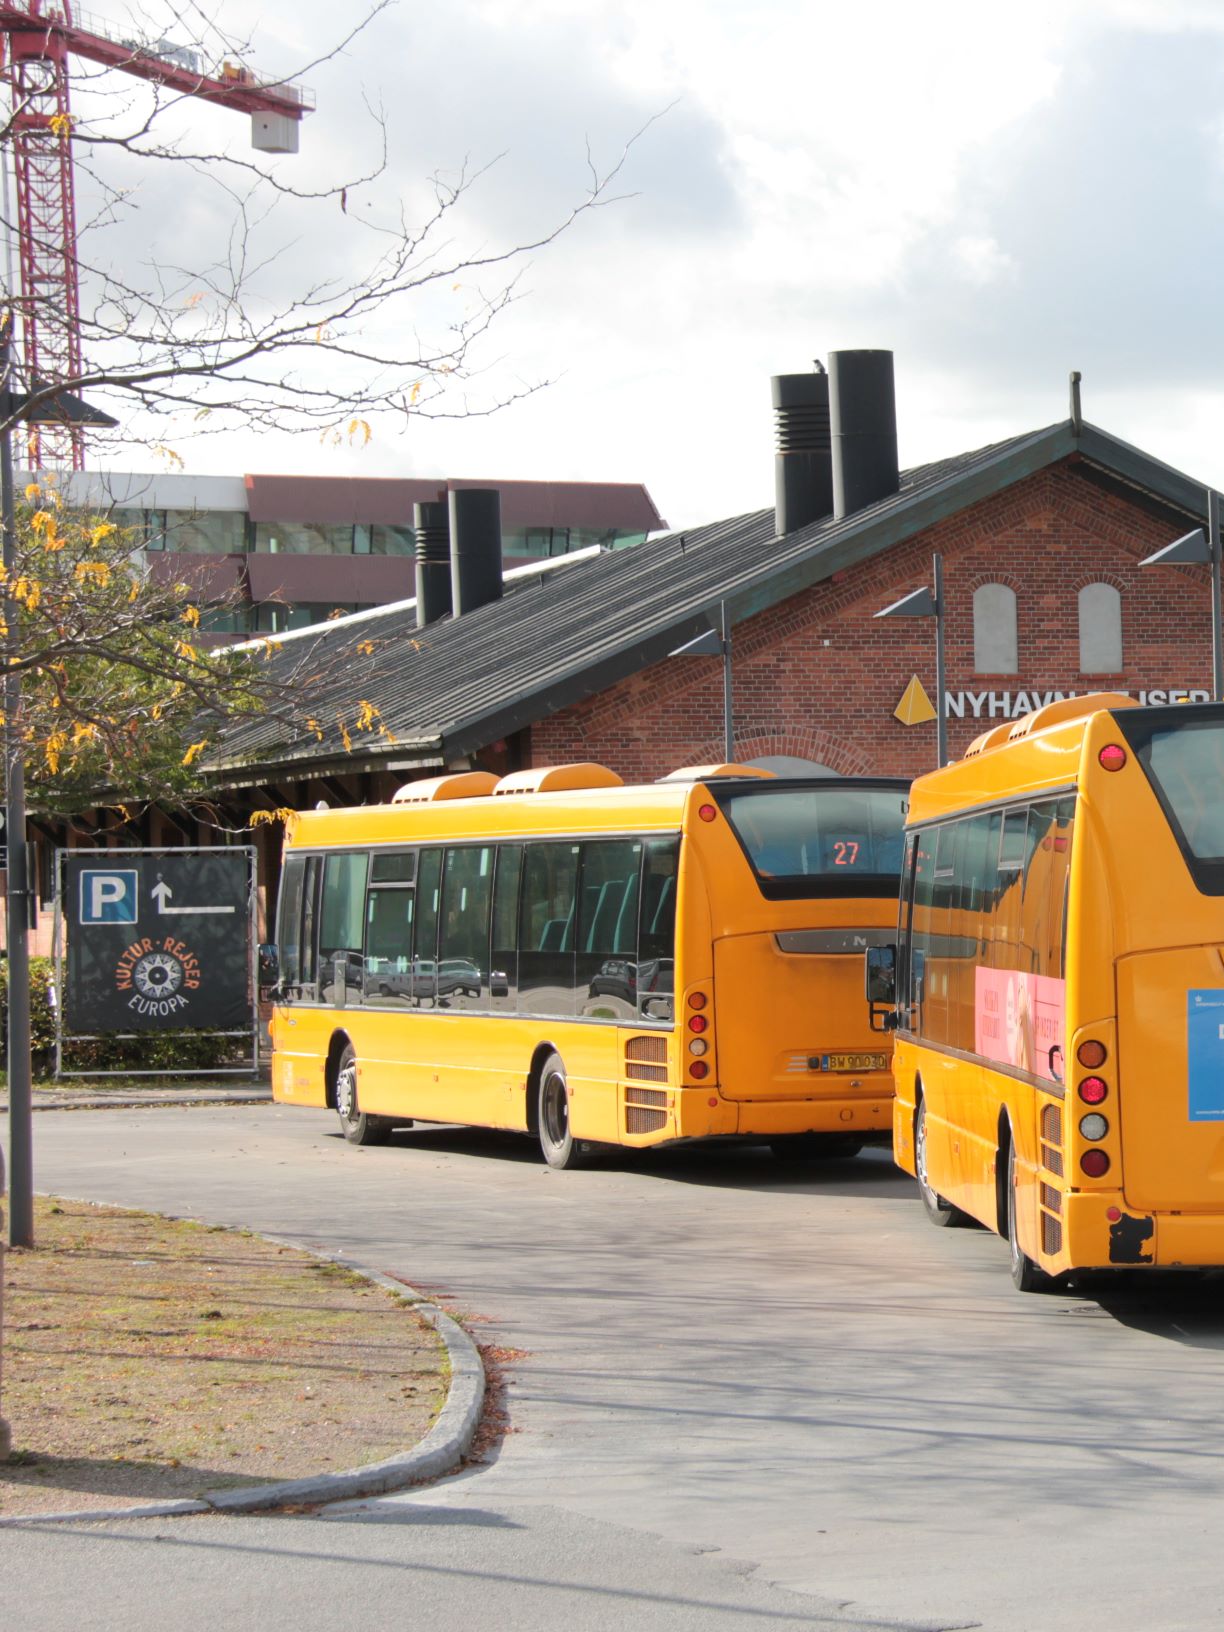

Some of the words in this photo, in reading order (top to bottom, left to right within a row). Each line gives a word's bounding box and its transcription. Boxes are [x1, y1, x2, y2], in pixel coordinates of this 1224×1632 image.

[833, 841, 859, 865] 27
[91, 876, 126, 918] P
[116, 937, 154, 990] KULTUR
[162, 936, 200, 989] REJSER
[128, 993, 190, 1017] EUROPA
[830, 1055, 845, 1068] BW
[847, 1055, 862, 1068] 90
